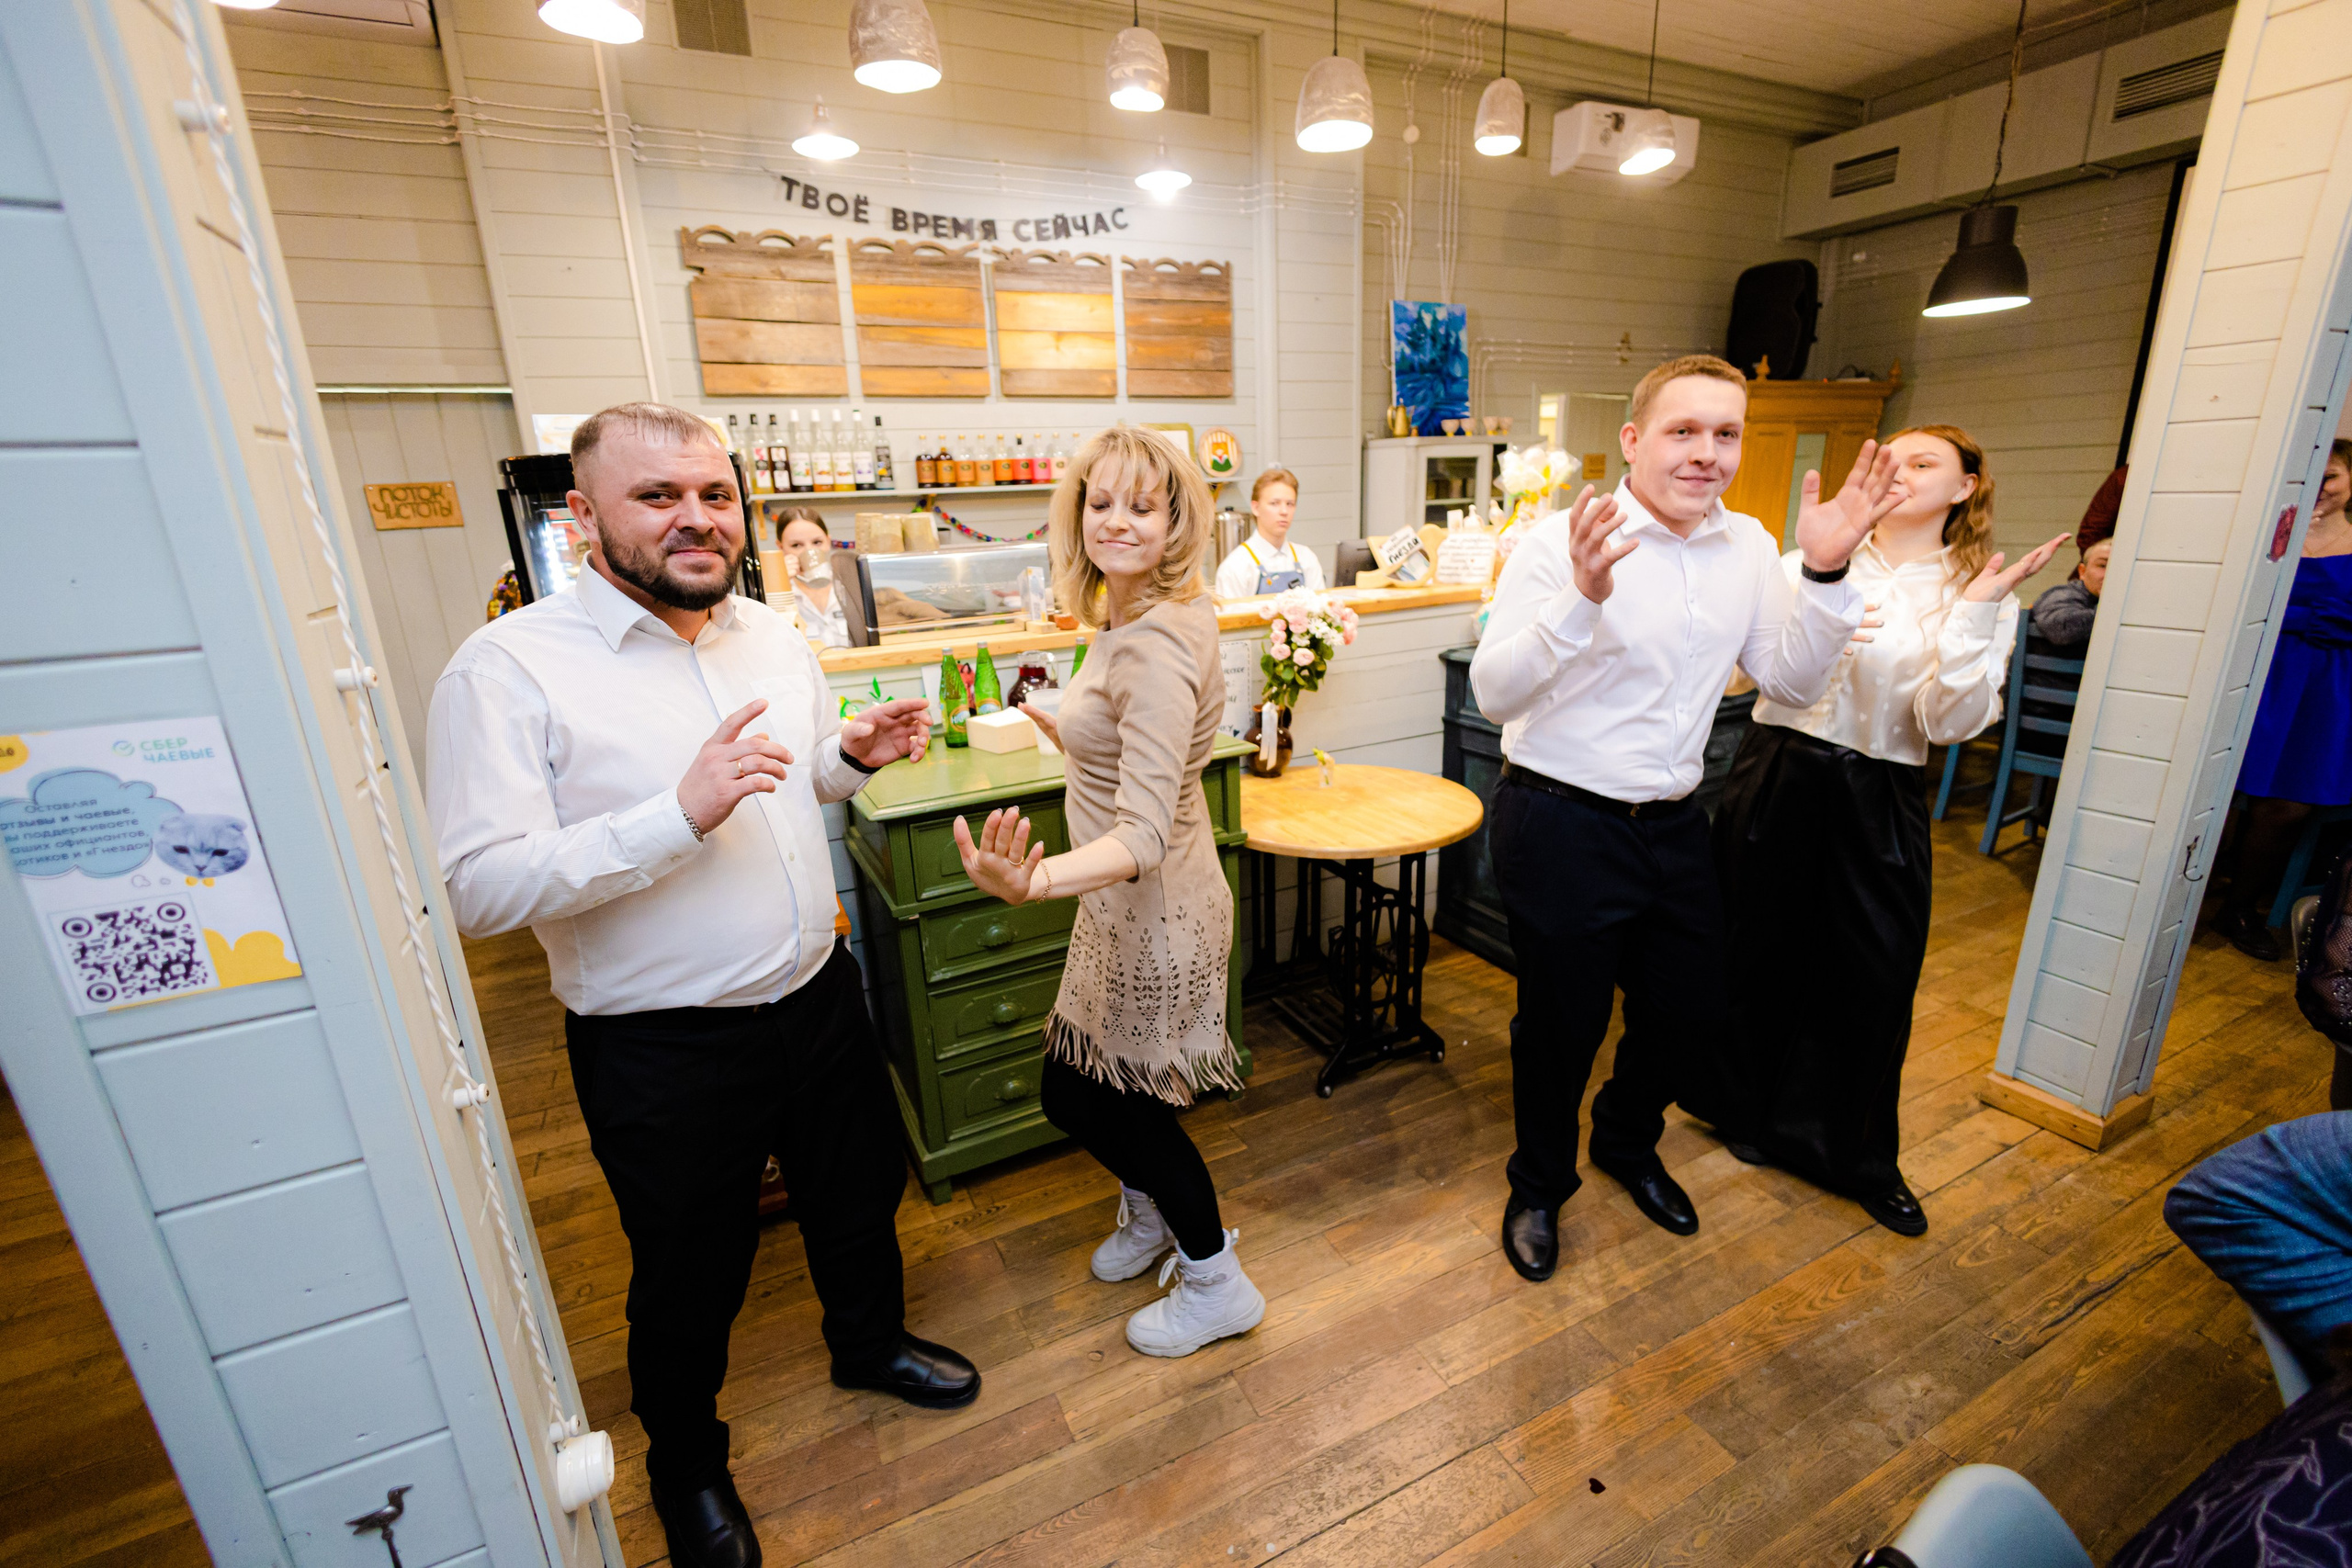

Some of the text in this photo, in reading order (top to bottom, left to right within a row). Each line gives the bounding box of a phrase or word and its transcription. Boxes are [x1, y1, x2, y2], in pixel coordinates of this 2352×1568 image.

[781, 175, 1129, 242] ТВОЁ ВРЕМЯ СЕЙЧАС
[379, 485, 446, 502] ПОТОК
[140, 737, 187, 751] СБЕР
[143, 747, 216, 763] ЧАЕВЫЕ
[25, 799, 97, 814] Оставляя
[61, 815, 69, 823] и
[74, 807, 135, 820] чаевые,
[23, 818, 140, 840] поддерживаете
[55, 829, 150, 849] официантов,
[73, 851, 82, 859] и
